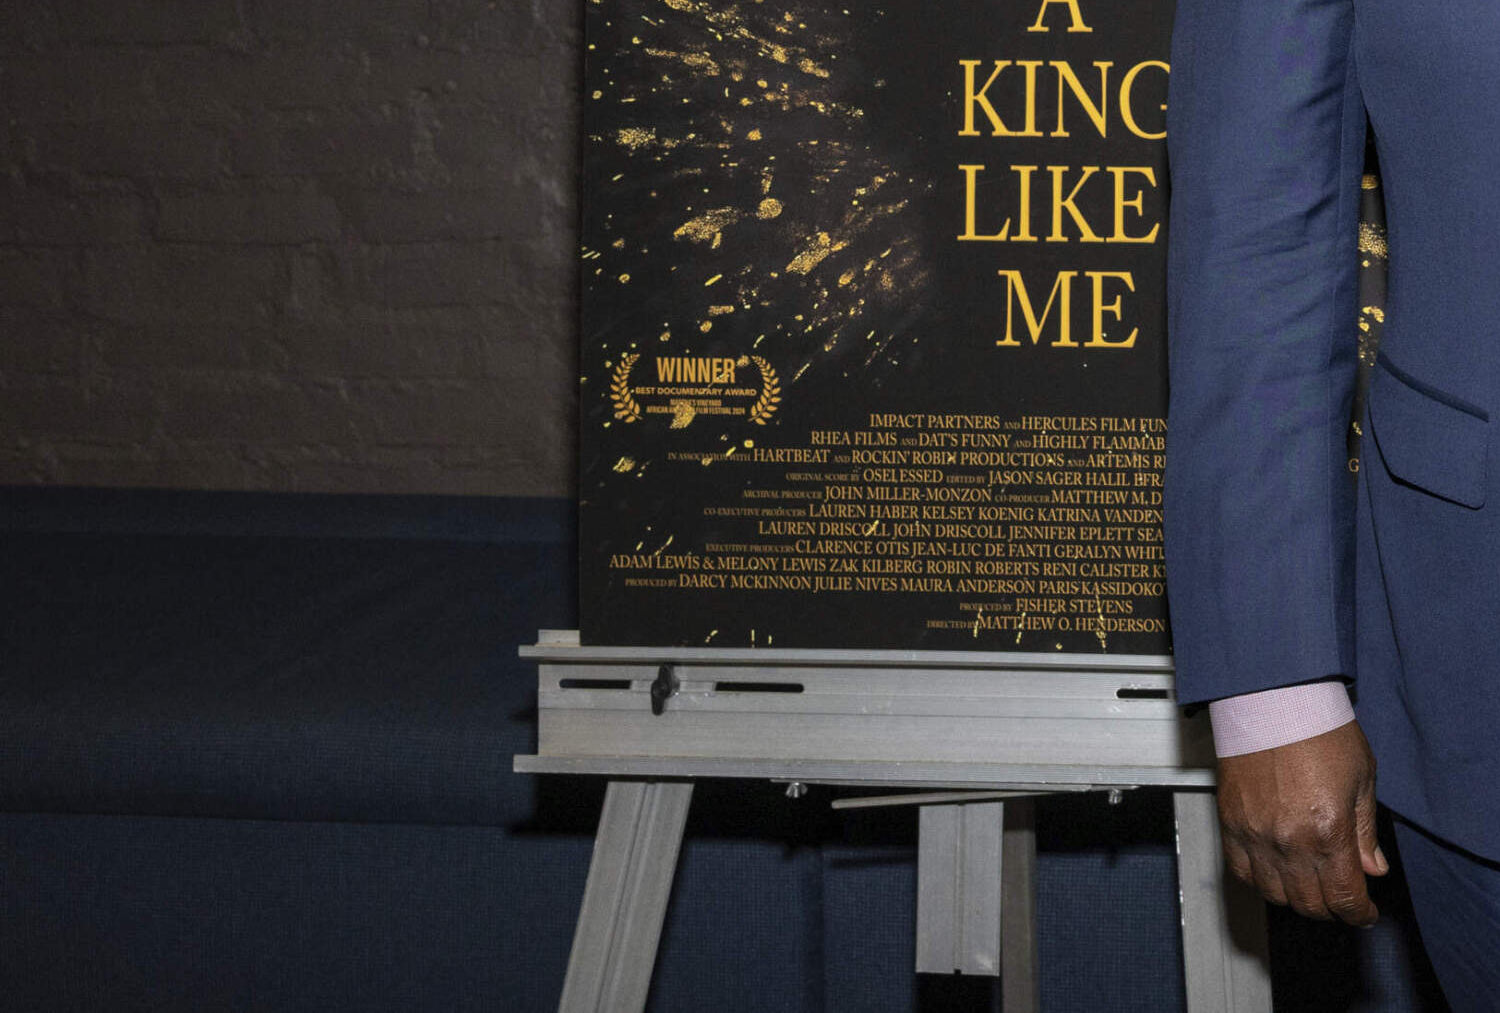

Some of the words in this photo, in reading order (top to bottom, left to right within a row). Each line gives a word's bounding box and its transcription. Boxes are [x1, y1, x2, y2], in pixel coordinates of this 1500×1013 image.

[957, 59, 1170, 140] KING
[957, 164, 1160, 244] LIKE
[996, 269, 1139, 348] ME
[656, 357, 736, 384] WINNER
[635, 386, 655, 395] BEST
[725, 388, 757, 396] AWARD
[869, 414, 925, 428] IMPACT
[928, 414, 1000, 429] PARTNERS
[1004, 421, 1020, 430] AND
[1021, 416, 1097, 432] HERCULES
[1101, 417, 1135, 432] FILM
[811, 431, 850, 445] RHEA
[855, 431, 897, 446] FILMS
[901, 437, 917, 446] AND
[919, 433, 958, 446] DAT'S
[961, 433, 1011, 447] FUNNY
[1015, 439, 1031, 448] AND
[1032, 434, 1090, 449] HIGHLY
[753, 448, 831, 463] HARTBEAT
[834, 455, 850, 463] AND
[851, 449, 910, 464] ROCKIN'
[912, 450, 957, 465] ROBIN
[960, 450, 1064, 466] PRODUCTIONS
[1086, 454, 1150, 468] ARTEMIS
[900, 469, 943, 483] ESSED
[988, 470, 1033, 486] JASON
[1036, 471, 1082, 485] SAGER
[1086, 471, 1130, 486] HALIL
[824, 485, 863, 502] JOHN
[867, 486, 992, 502] MILLER-MONZON
[1051, 489, 1128, 504] MATTHEW
[1131, 491, 1148, 504] M.
[809, 504, 866, 518] LAUREN
[870, 505, 918, 519] HABER
[922, 505, 975, 520] KELSEY
[979, 506, 1034, 521] KOENIG
[1038, 507, 1101, 522] KATRINA
[759, 521, 816, 535] LAUREN
[819, 522, 890, 536] DRISCOLL
[891, 523, 931, 539] JOHN
[935, 523, 1006, 538] DRISCOLL
[1007, 525, 1076, 542] JENNIFER
[1080, 526, 1134, 541] EPLETT
[795, 539, 872, 554] CLARENCE
[875, 541, 909, 555] OTIS
[910, 542, 981, 558] JEAN-LUC
[985, 543, 1005, 557] DE
[1008, 544, 1051, 558] FANTI
[1054, 545, 1122, 559] GERALYN
[609, 554, 652, 568] ADAM
[656, 555, 700, 569] LEWIS
[703, 557, 715, 570] &
[717, 556, 779, 571] MELONY
[782, 558, 826, 572] LEWIS
[829, 559, 858, 572] ZAK
[862, 559, 922, 573] KILBERG
[926, 560, 972, 574] ROBIN
[975, 561, 1040, 575] ROBERTS
[1043, 562, 1076, 576] RENI
[1079, 563, 1150, 578] CALISTER
[679, 573, 728, 588] DARCY
[730, 574, 811, 589] MCKINNON
[812, 576, 852, 593] JULIE
[856, 577, 897, 591] NIVES
[901, 578, 952, 592] MAURA
[956, 579, 1035, 593] ANDERSON
[1039, 581, 1079, 595] PARIS
[1082, 581, 1164, 596] KASSIDOKO
[1016, 598, 1066, 613] FISHER
[1069, 599, 1133, 614] STEVENS
[978, 615, 1055, 631] MATTHEW
[1058, 617, 1073, 632] O.
[1075, 617, 1166, 634] HENDERSON
